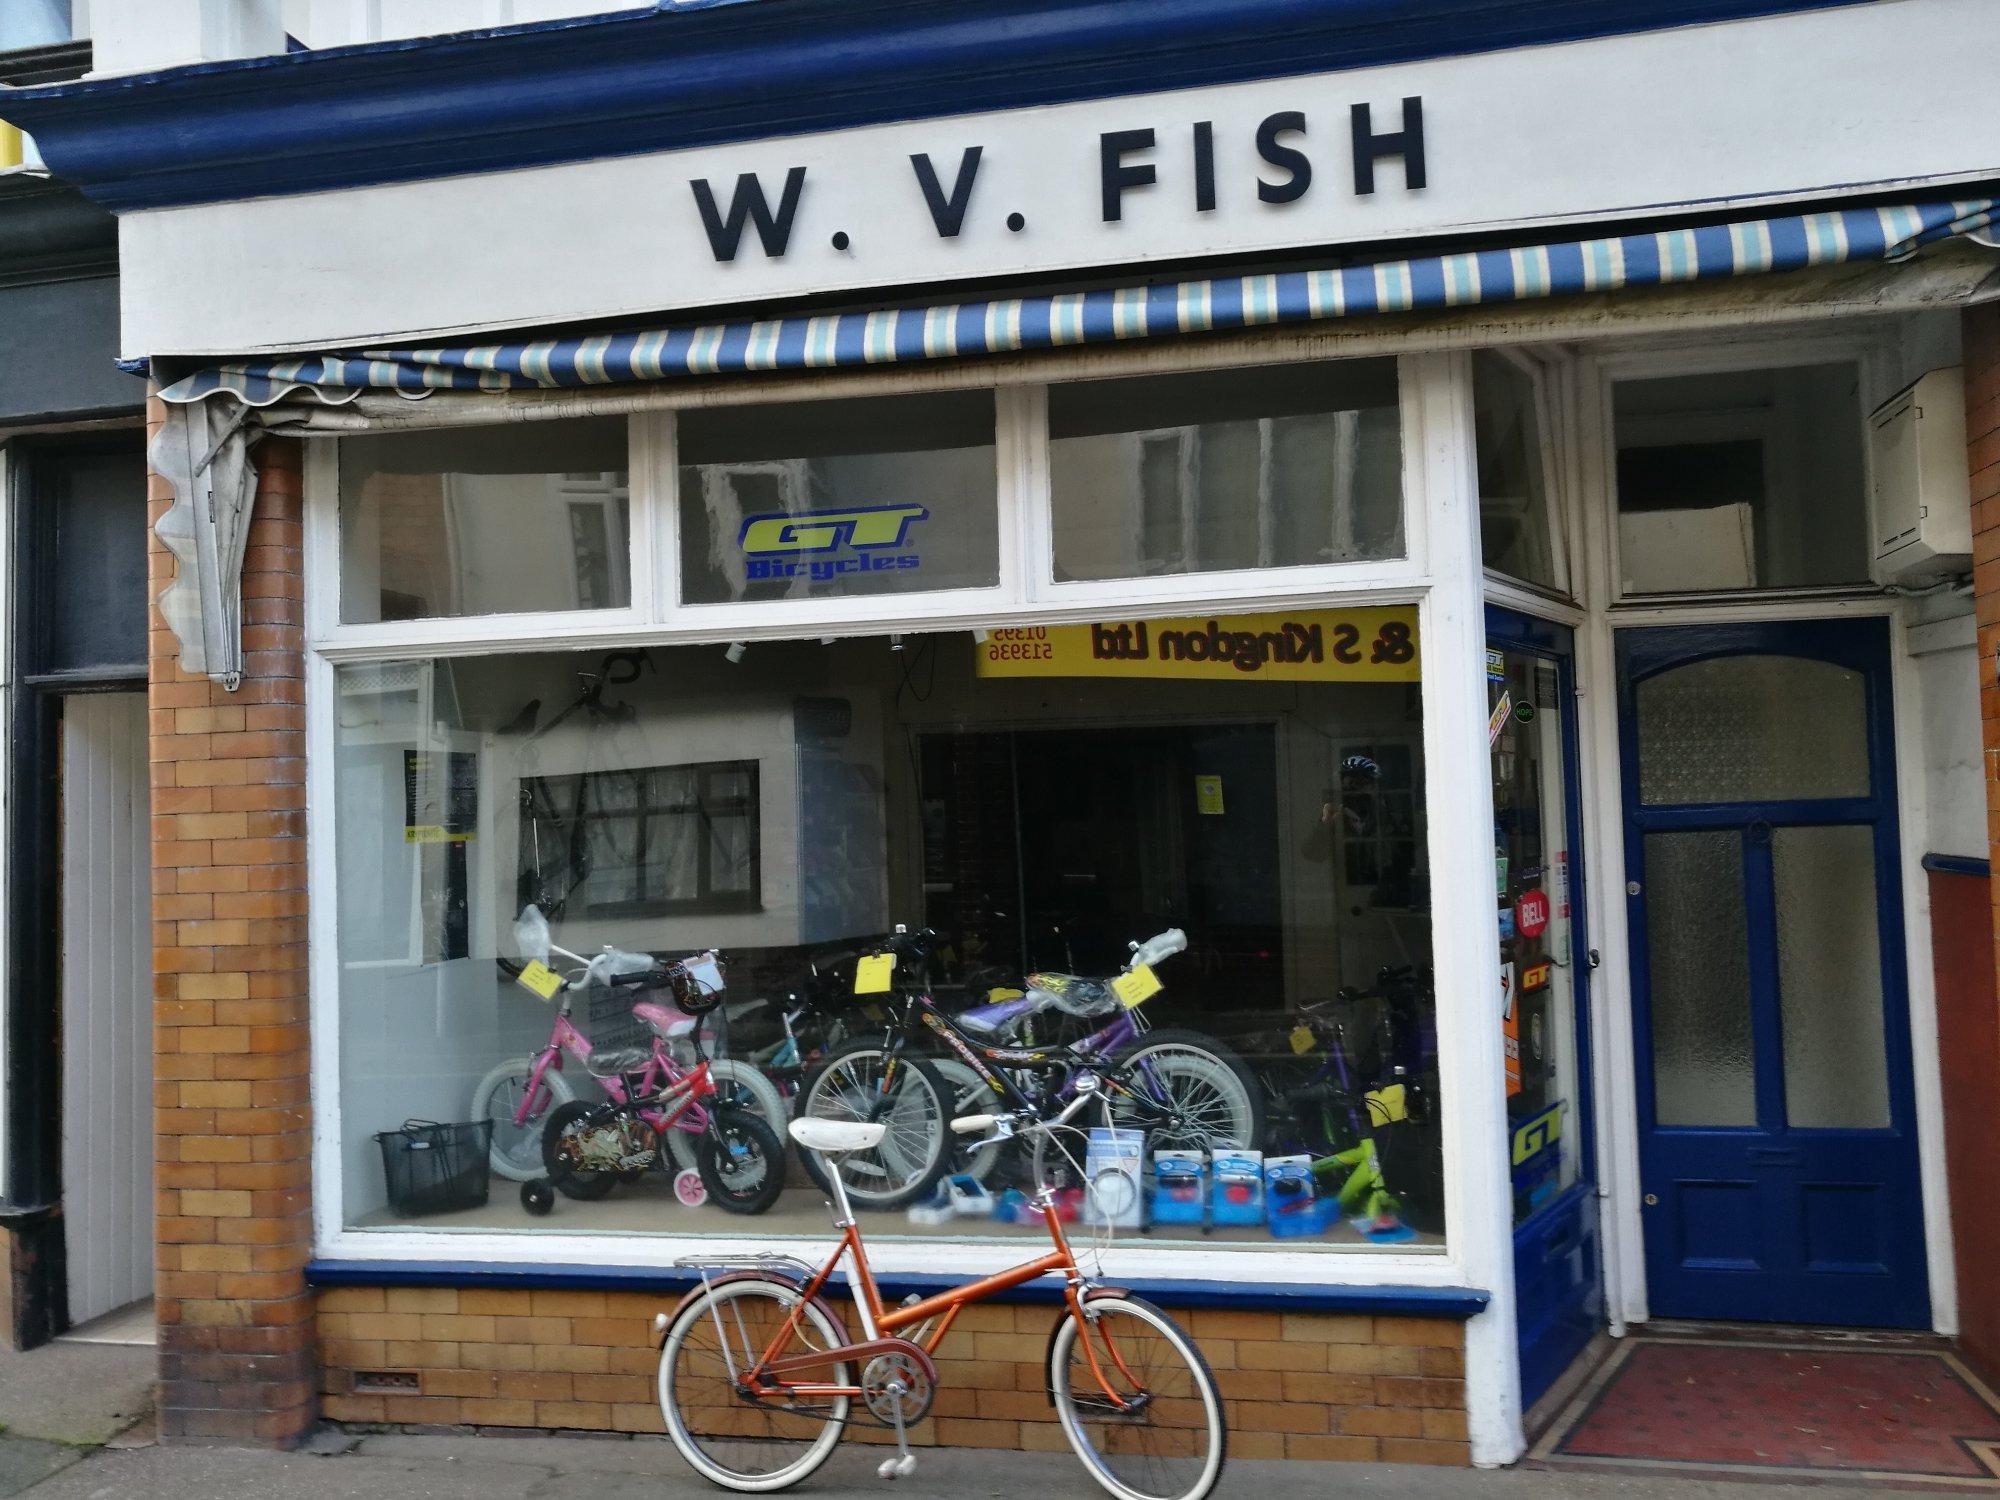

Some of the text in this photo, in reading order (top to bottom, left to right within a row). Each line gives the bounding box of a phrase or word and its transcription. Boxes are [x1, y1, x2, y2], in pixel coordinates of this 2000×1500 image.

[1100, 96, 1427, 223] FISH
[738, 503, 930, 557] GT
[746, 553, 920, 581] Bicycles
[1522, 900, 1545, 928] BELL
[1522, 964, 1550, 990] GT
[1511, 1099, 1568, 1167] GT
